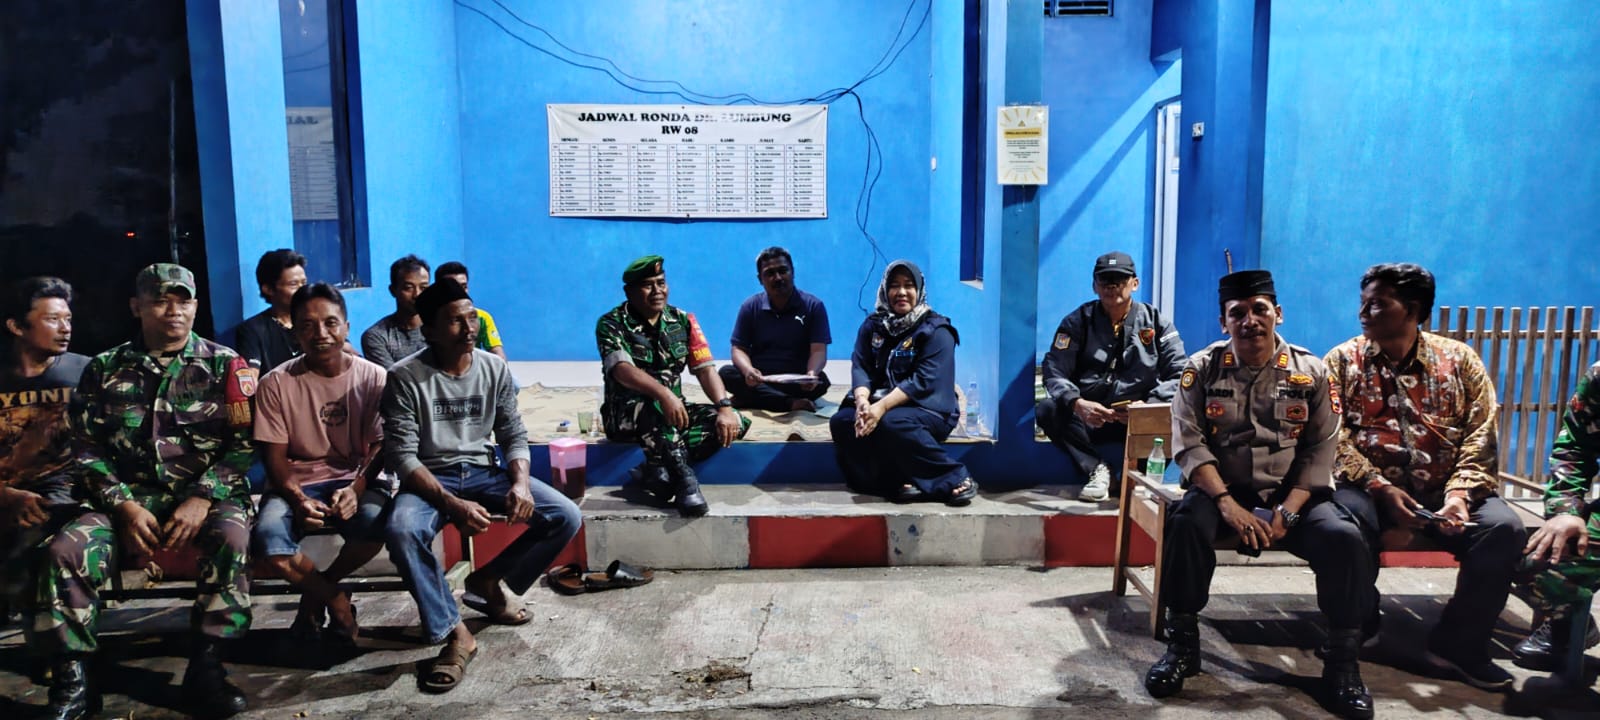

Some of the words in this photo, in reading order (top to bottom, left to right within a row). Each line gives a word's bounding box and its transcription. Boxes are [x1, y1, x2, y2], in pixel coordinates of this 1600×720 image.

[578, 112, 638, 122] JADWAL
[640, 112, 691, 122] RONDA
[661, 125, 682, 135] RW
[684, 126, 698, 135] 08
